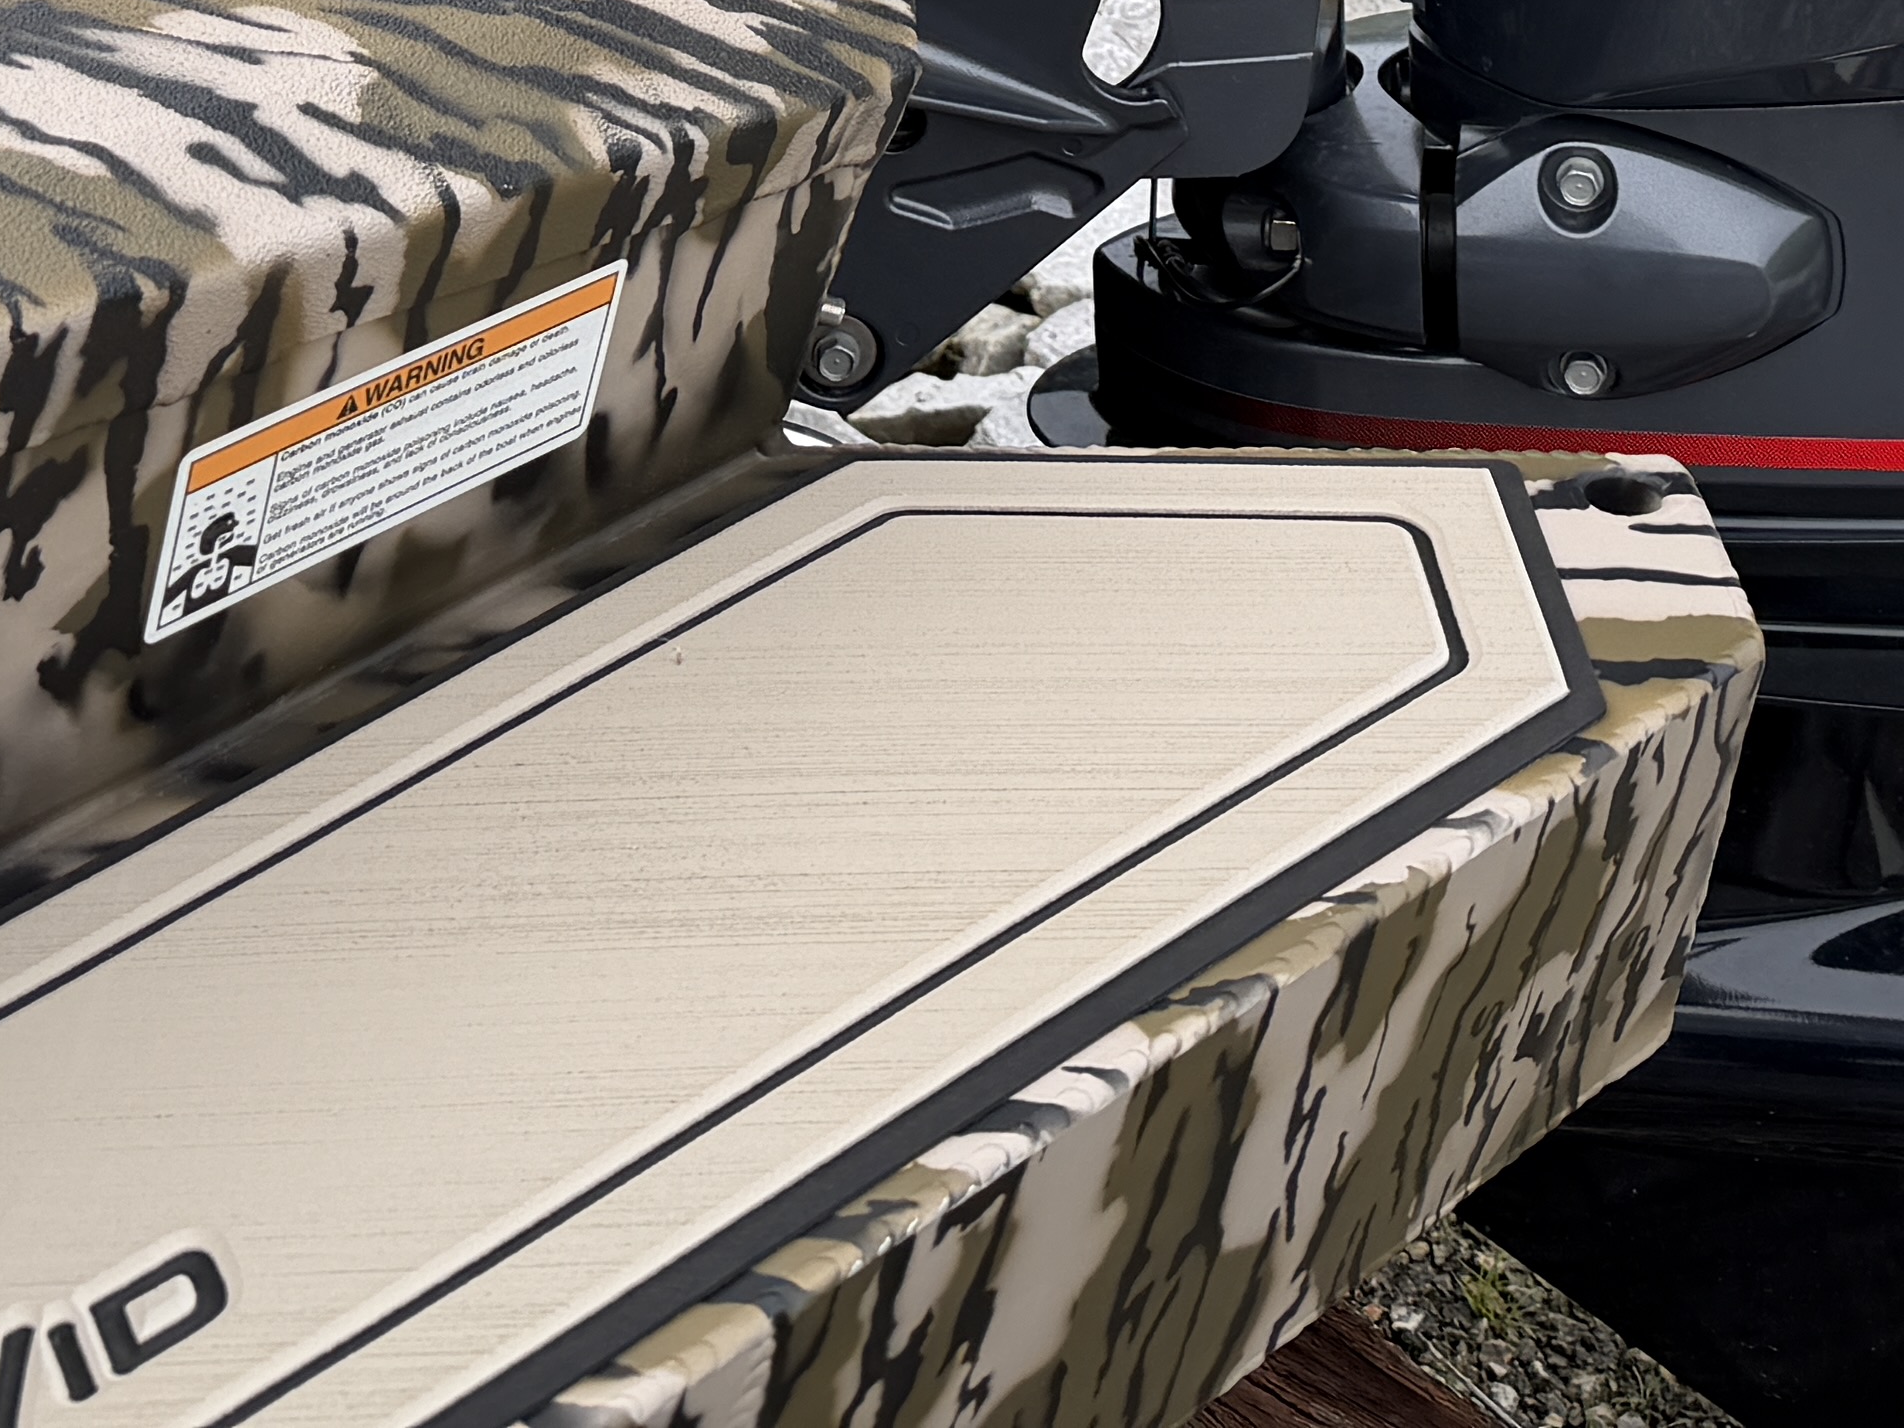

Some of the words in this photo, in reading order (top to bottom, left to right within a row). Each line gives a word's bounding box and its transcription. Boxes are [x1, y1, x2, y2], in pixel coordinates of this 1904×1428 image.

[279, 434, 322, 462] Carbon
[323, 409, 379, 443] monoxide
[379, 395, 407, 419] (CO)
[407, 388, 427, 405] can
[428, 373, 460, 395] cause
[364, 337, 487, 407] WARNING
[274, 456, 314, 486] Engine
[315, 447, 336, 465] and
[429, 384, 472, 412] contains
[516, 355, 537, 372] and
[300, 485, 313, 500] of
[313, 467, 352, 493] carbon
[452, 403, 489, 429] include
[382, 453, 403, 470] and
[404, 443, 425, 460] lack
[425, 437, 438, 450] of
[257, 537, 298, 566] Carbon
[298, 512, 350, 546] monoxide
[350, 503, 369, 521] will
[368, 496, 384, 512] be
[384, 479, 421, 505] around
[420, 470, 439, 487] the
[439, 458, 465, 479] back
[464, 452, 477, 466] of
[476, 444, 494, 461] the
[494, 433, 518, 453] boat
[517, 420, 546, 441] when
[262, 526, 283, 546] Get
[283, 513, 312, 536] fresh
[312, 506, 328, 522] air
[327, 501, 337, 514] if
[336, 483, 376, 512] anyone
[376, 466, 411, 491] shows
[410, 453, 439, 477] signs
[439, 447, 451, 462] of
[451, 430, 487, 456] carbon
[326, 525, 346, 541] are
